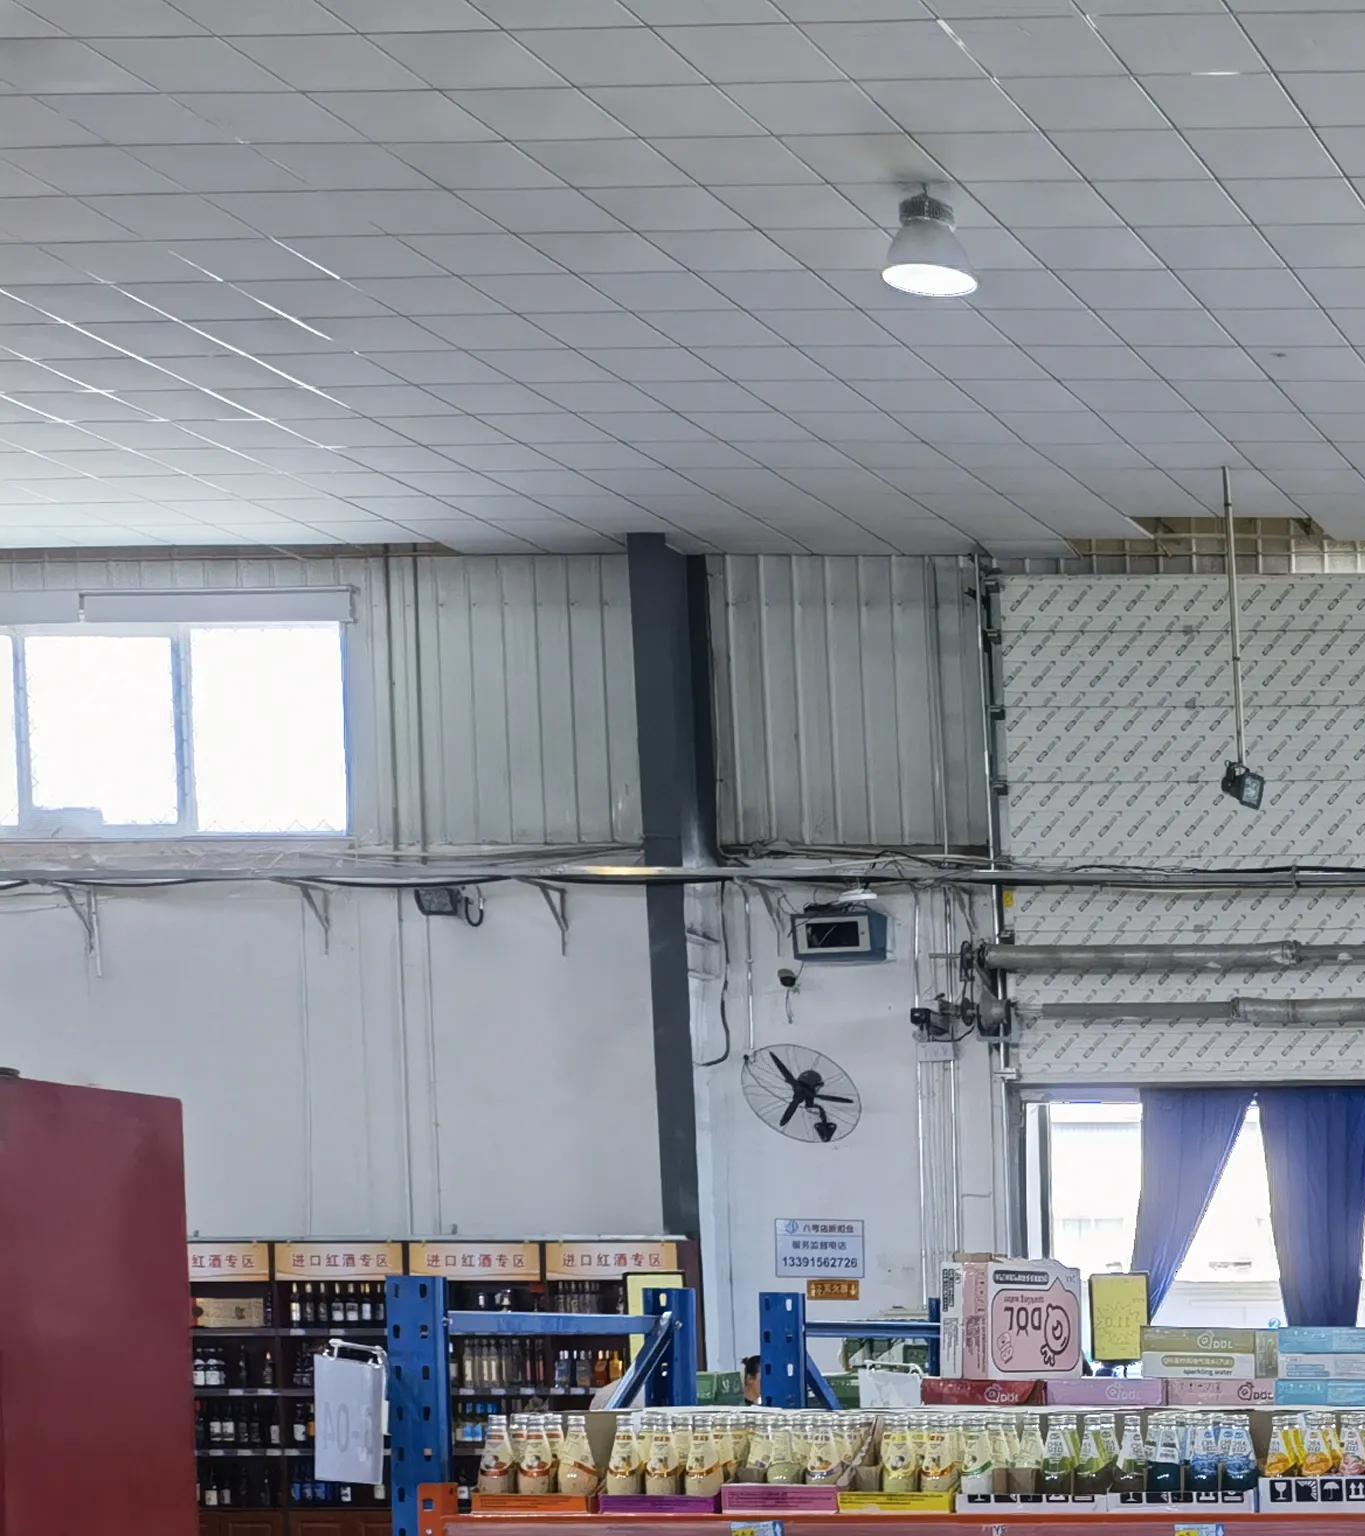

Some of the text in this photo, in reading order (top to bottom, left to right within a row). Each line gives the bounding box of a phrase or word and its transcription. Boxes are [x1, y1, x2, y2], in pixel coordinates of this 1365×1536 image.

[191, 1253, 256, 1268] 红酒专区
[291, 1252, 390, 1269] 进口红酒专区
[425, 1252, 528, 1269] 进口红酒专区
[561, 1252, 664, 1268] 进口红酒专区
